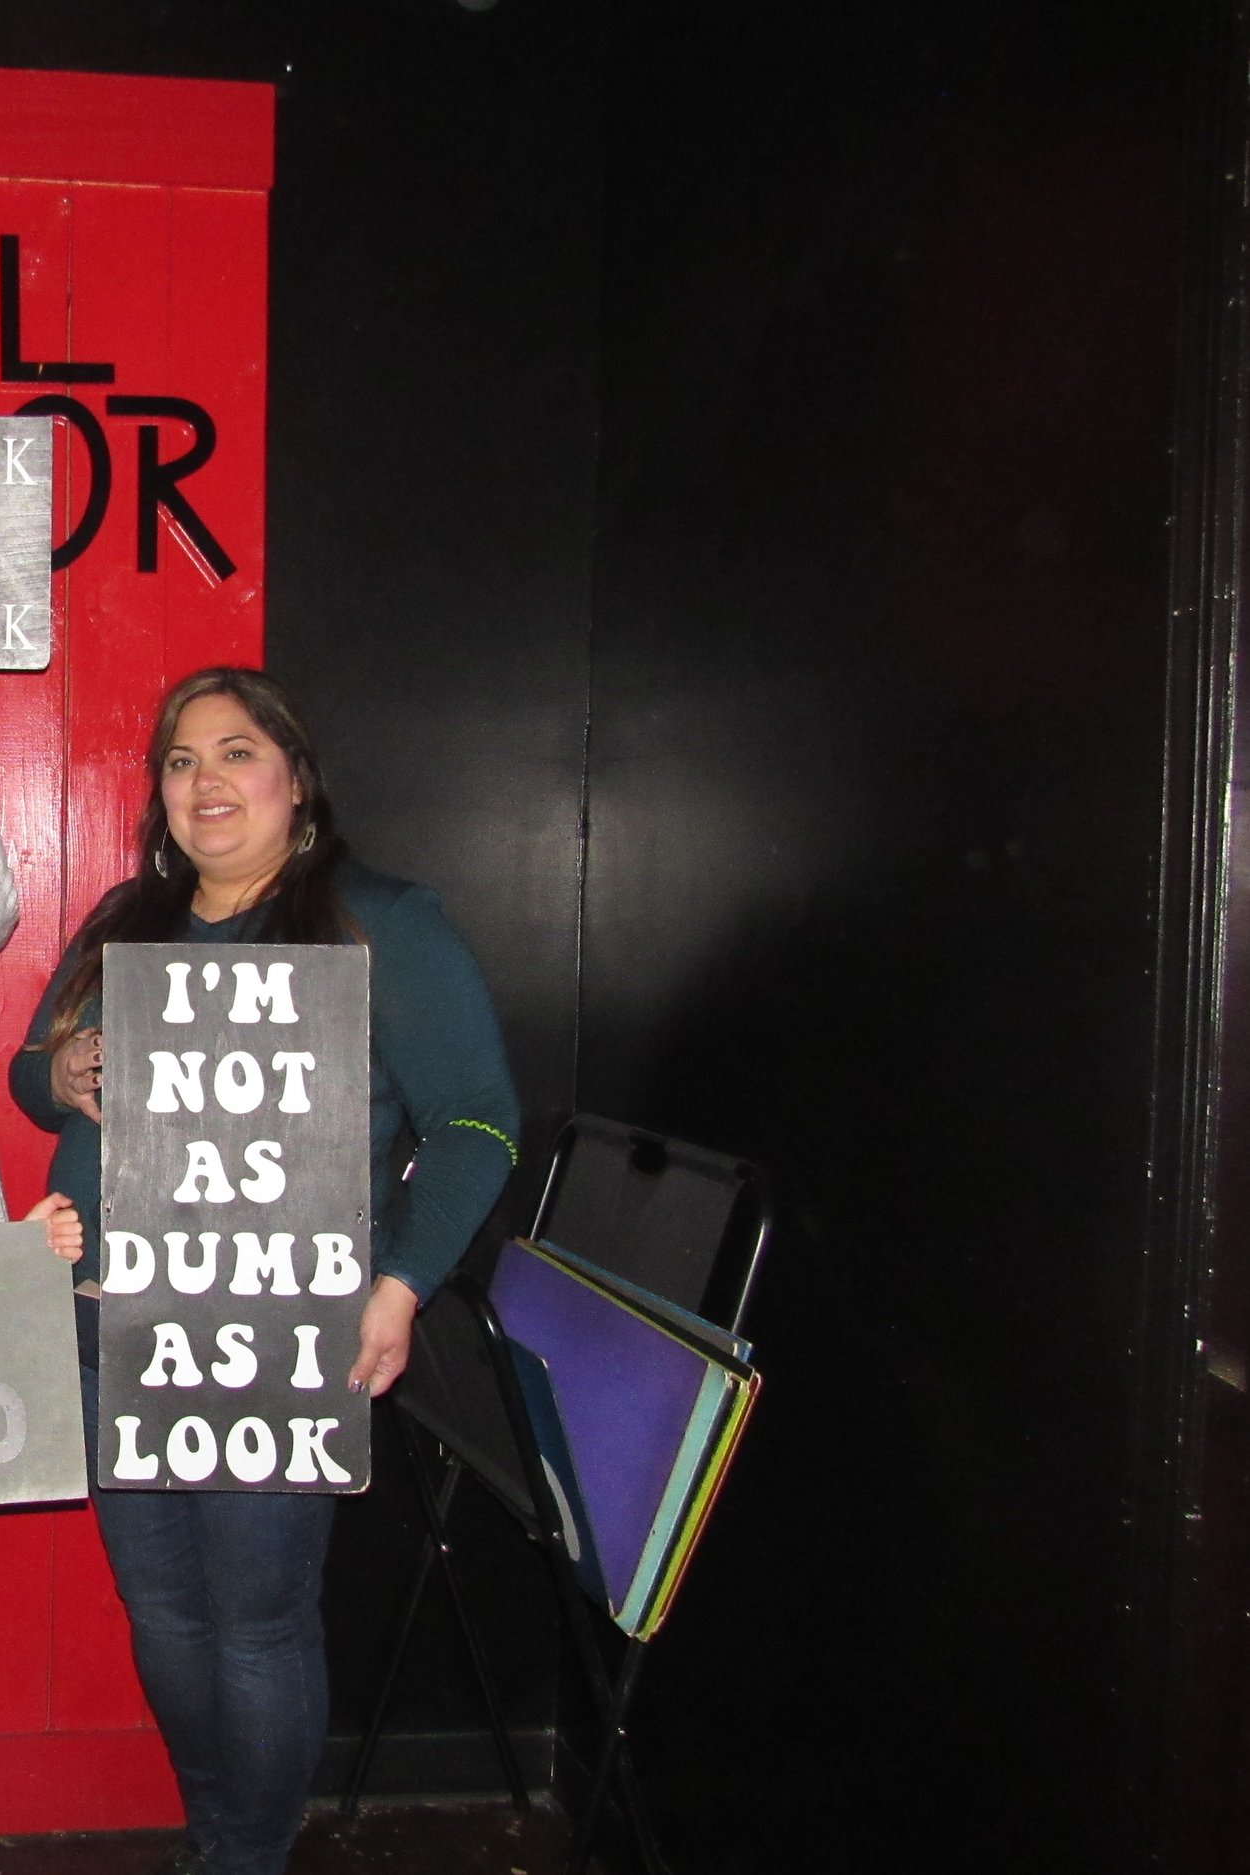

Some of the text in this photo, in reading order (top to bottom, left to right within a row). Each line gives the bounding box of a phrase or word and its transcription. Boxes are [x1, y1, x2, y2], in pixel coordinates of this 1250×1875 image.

[162, 961, 299, 1024] I'M
[145, 1050, 316, 1114] NOT
[172, 1140, 287, 1204] AS
[102, 1230, 363, 1297] DUMB
[140, 1322, 325, 1389] AS I
[113, 1415, 352, 1483] LOOK
